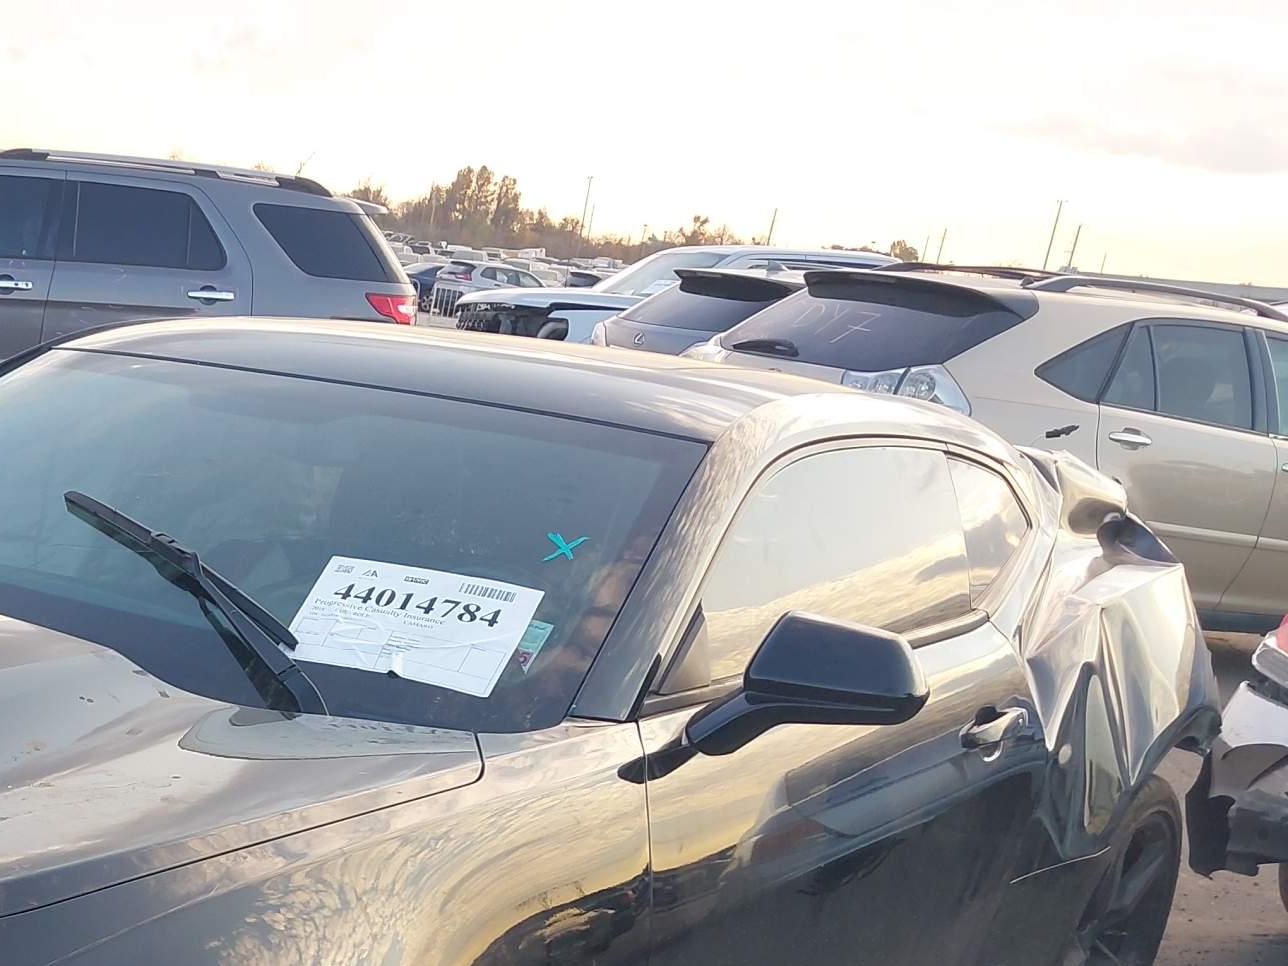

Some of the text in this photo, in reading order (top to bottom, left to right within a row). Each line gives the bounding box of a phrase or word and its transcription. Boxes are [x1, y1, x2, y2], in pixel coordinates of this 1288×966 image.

[314, 598, 362, 611] Progressive
[364, 605, 403, 618] Casualty
[403, 612, 446, 625] Insurance
[333, 583, 502, 628] 44014784
